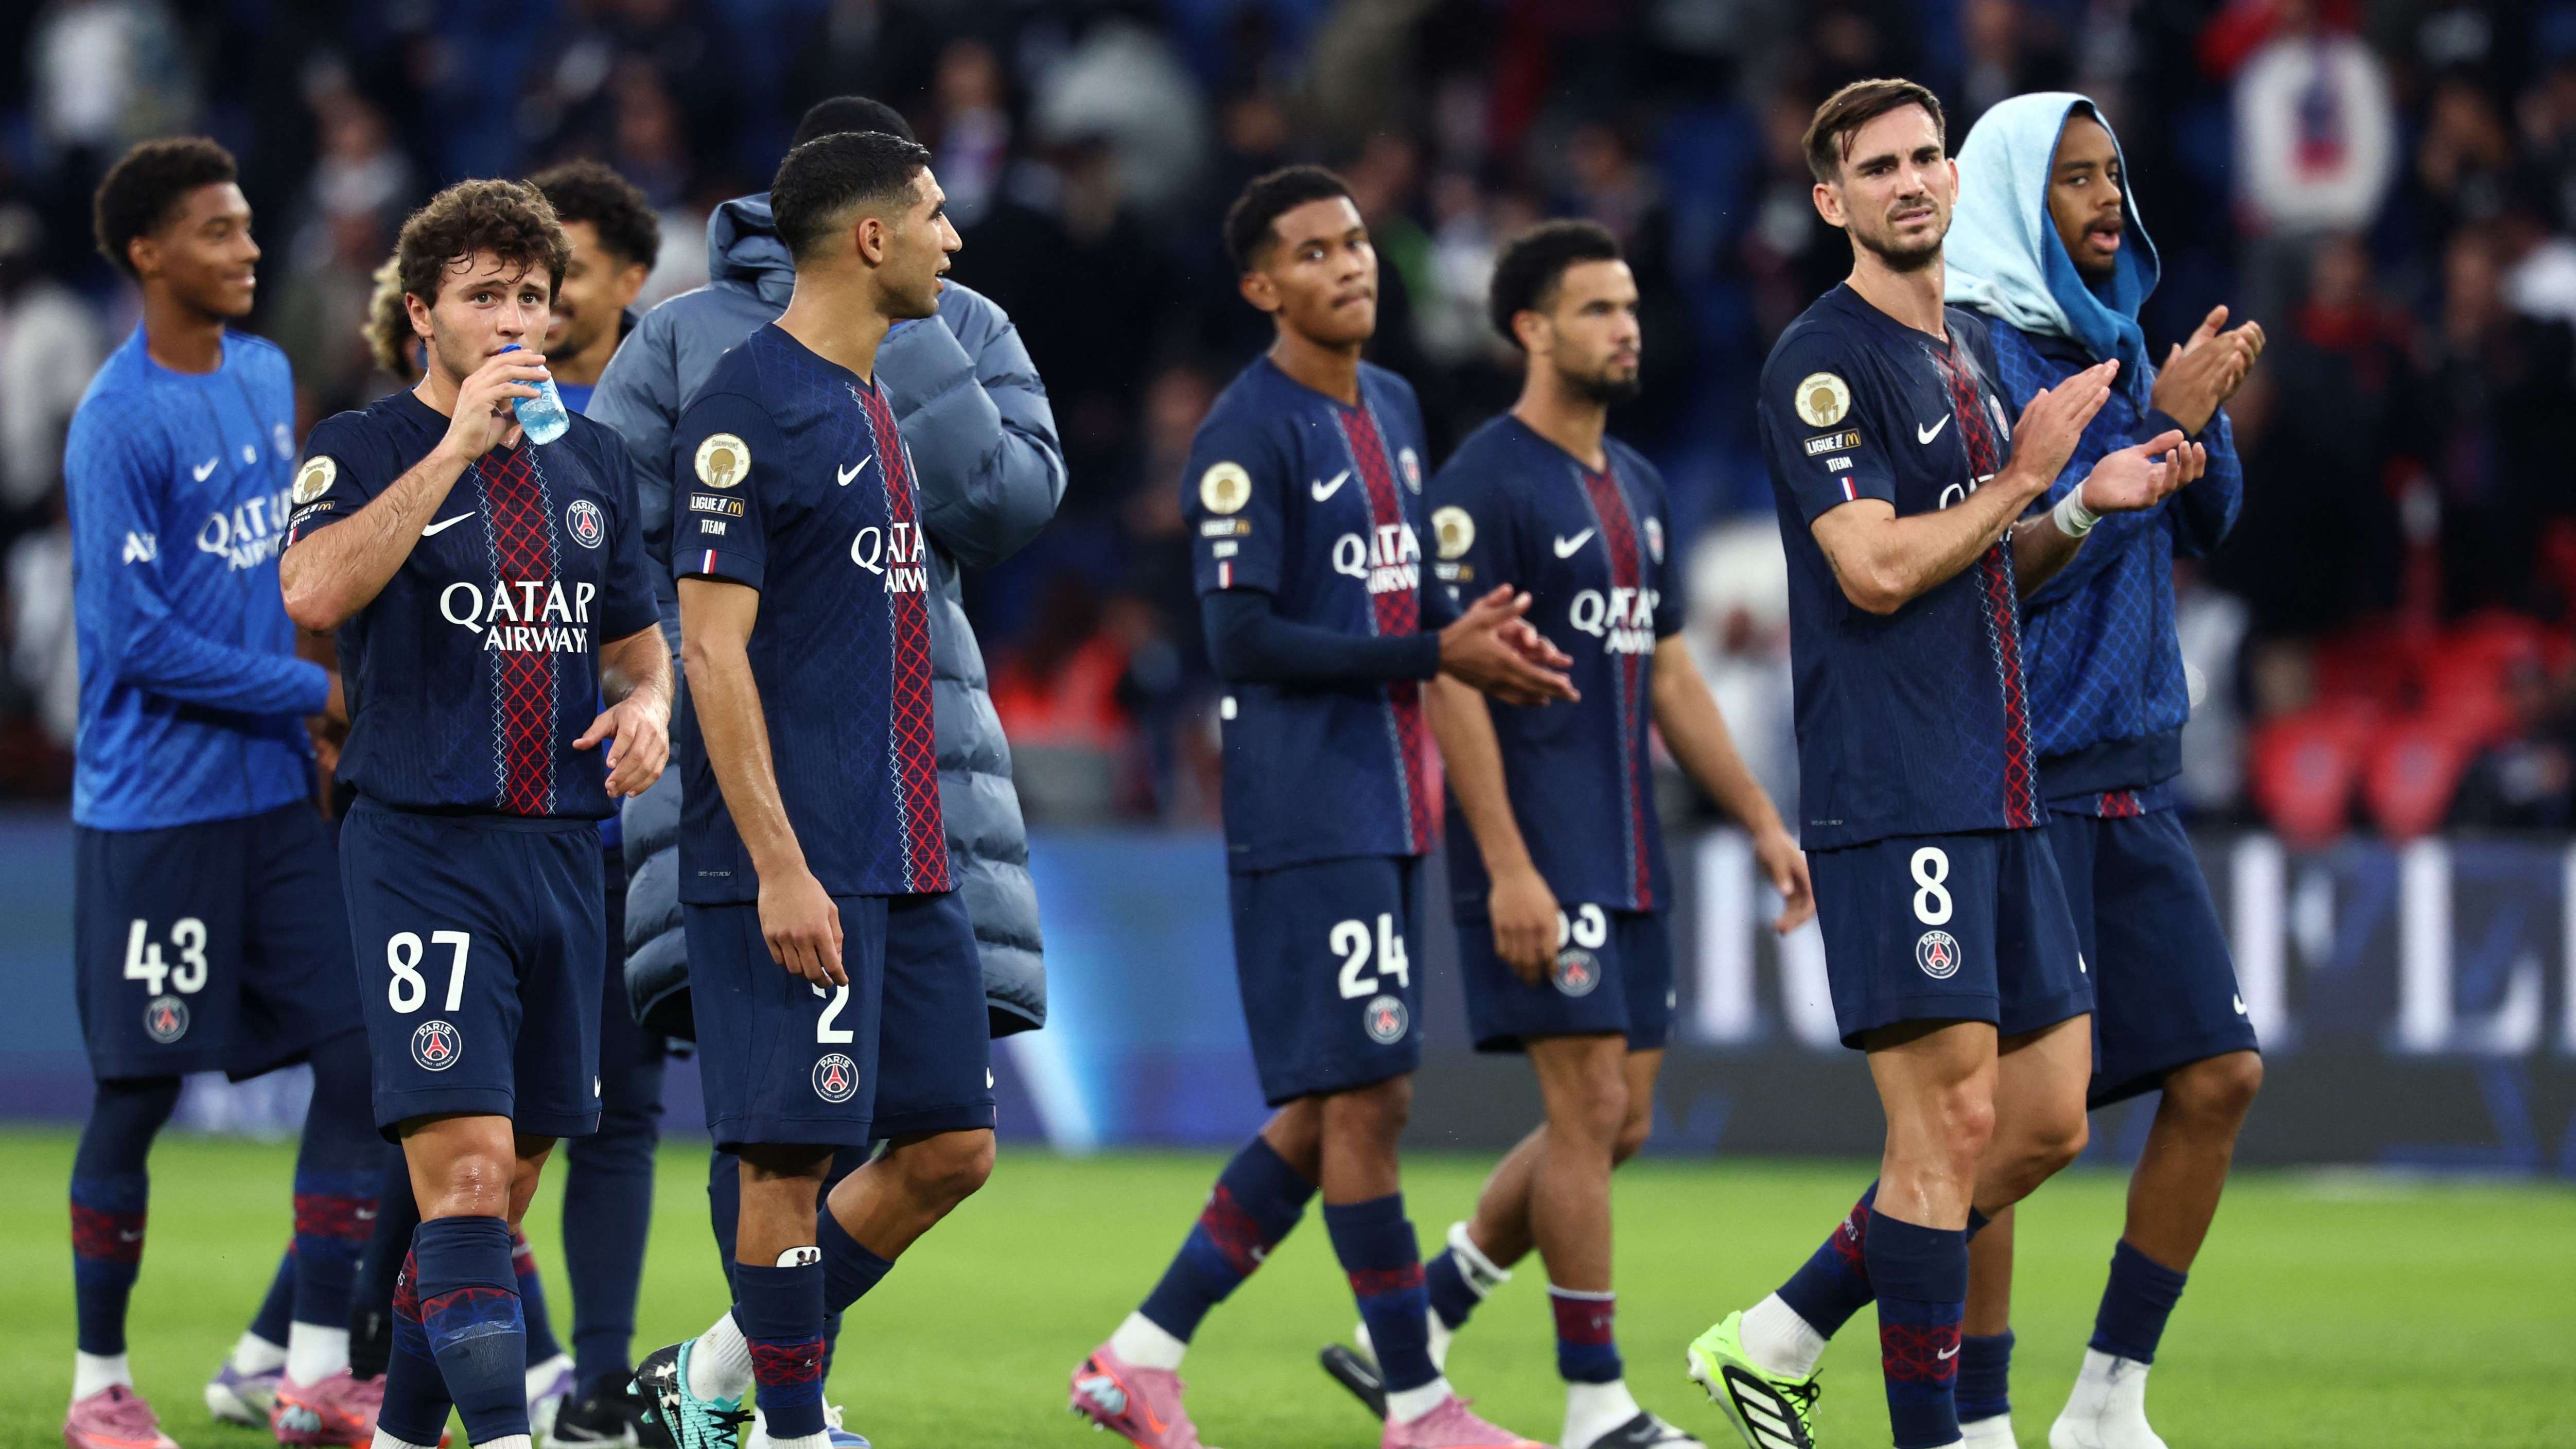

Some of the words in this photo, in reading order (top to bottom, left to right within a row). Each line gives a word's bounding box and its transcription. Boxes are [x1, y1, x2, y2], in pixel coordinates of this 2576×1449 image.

[1807, 437, 1835, 454] LIGUE
[571, 502, 597, 515] PARIS
[691, 496, 717, 511] LIGUE
[440, 580, 595, 634] QATAR
[1911, 847, 1953, 926] 8
[124, 917, 208, 996] 43
[1329, 912, 1410, 1000] 24
[1922, 933, 1951, 946] PARIS
[387, 930, 470, 1014] 87
[812, 967, 854, 1043] 2
[418, 1023, 452, 1037] PARIS
[820, 1056, 851, 1069] PARIS
